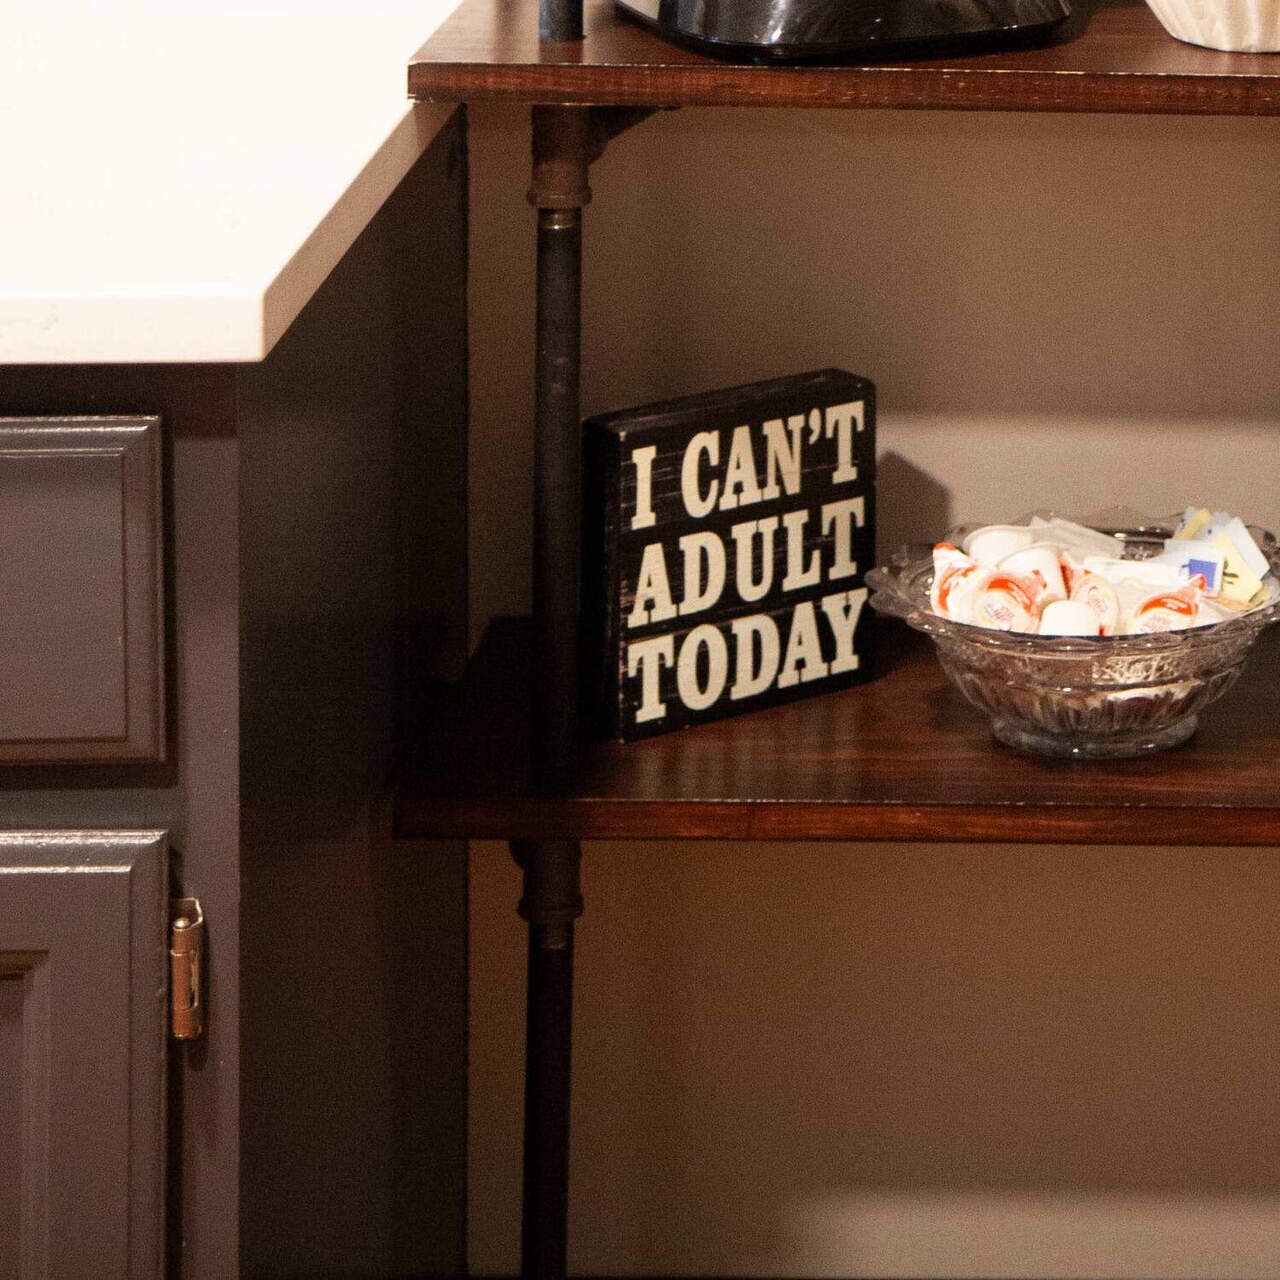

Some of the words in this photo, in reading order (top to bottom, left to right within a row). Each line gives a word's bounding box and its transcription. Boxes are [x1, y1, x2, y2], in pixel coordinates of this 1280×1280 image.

[630, 444, 658, 531] I
[680, 400, 865, 520] CAN'T
[626, 495, 866, 630] ADULT
[626, 586, 869, 725] TODAY
